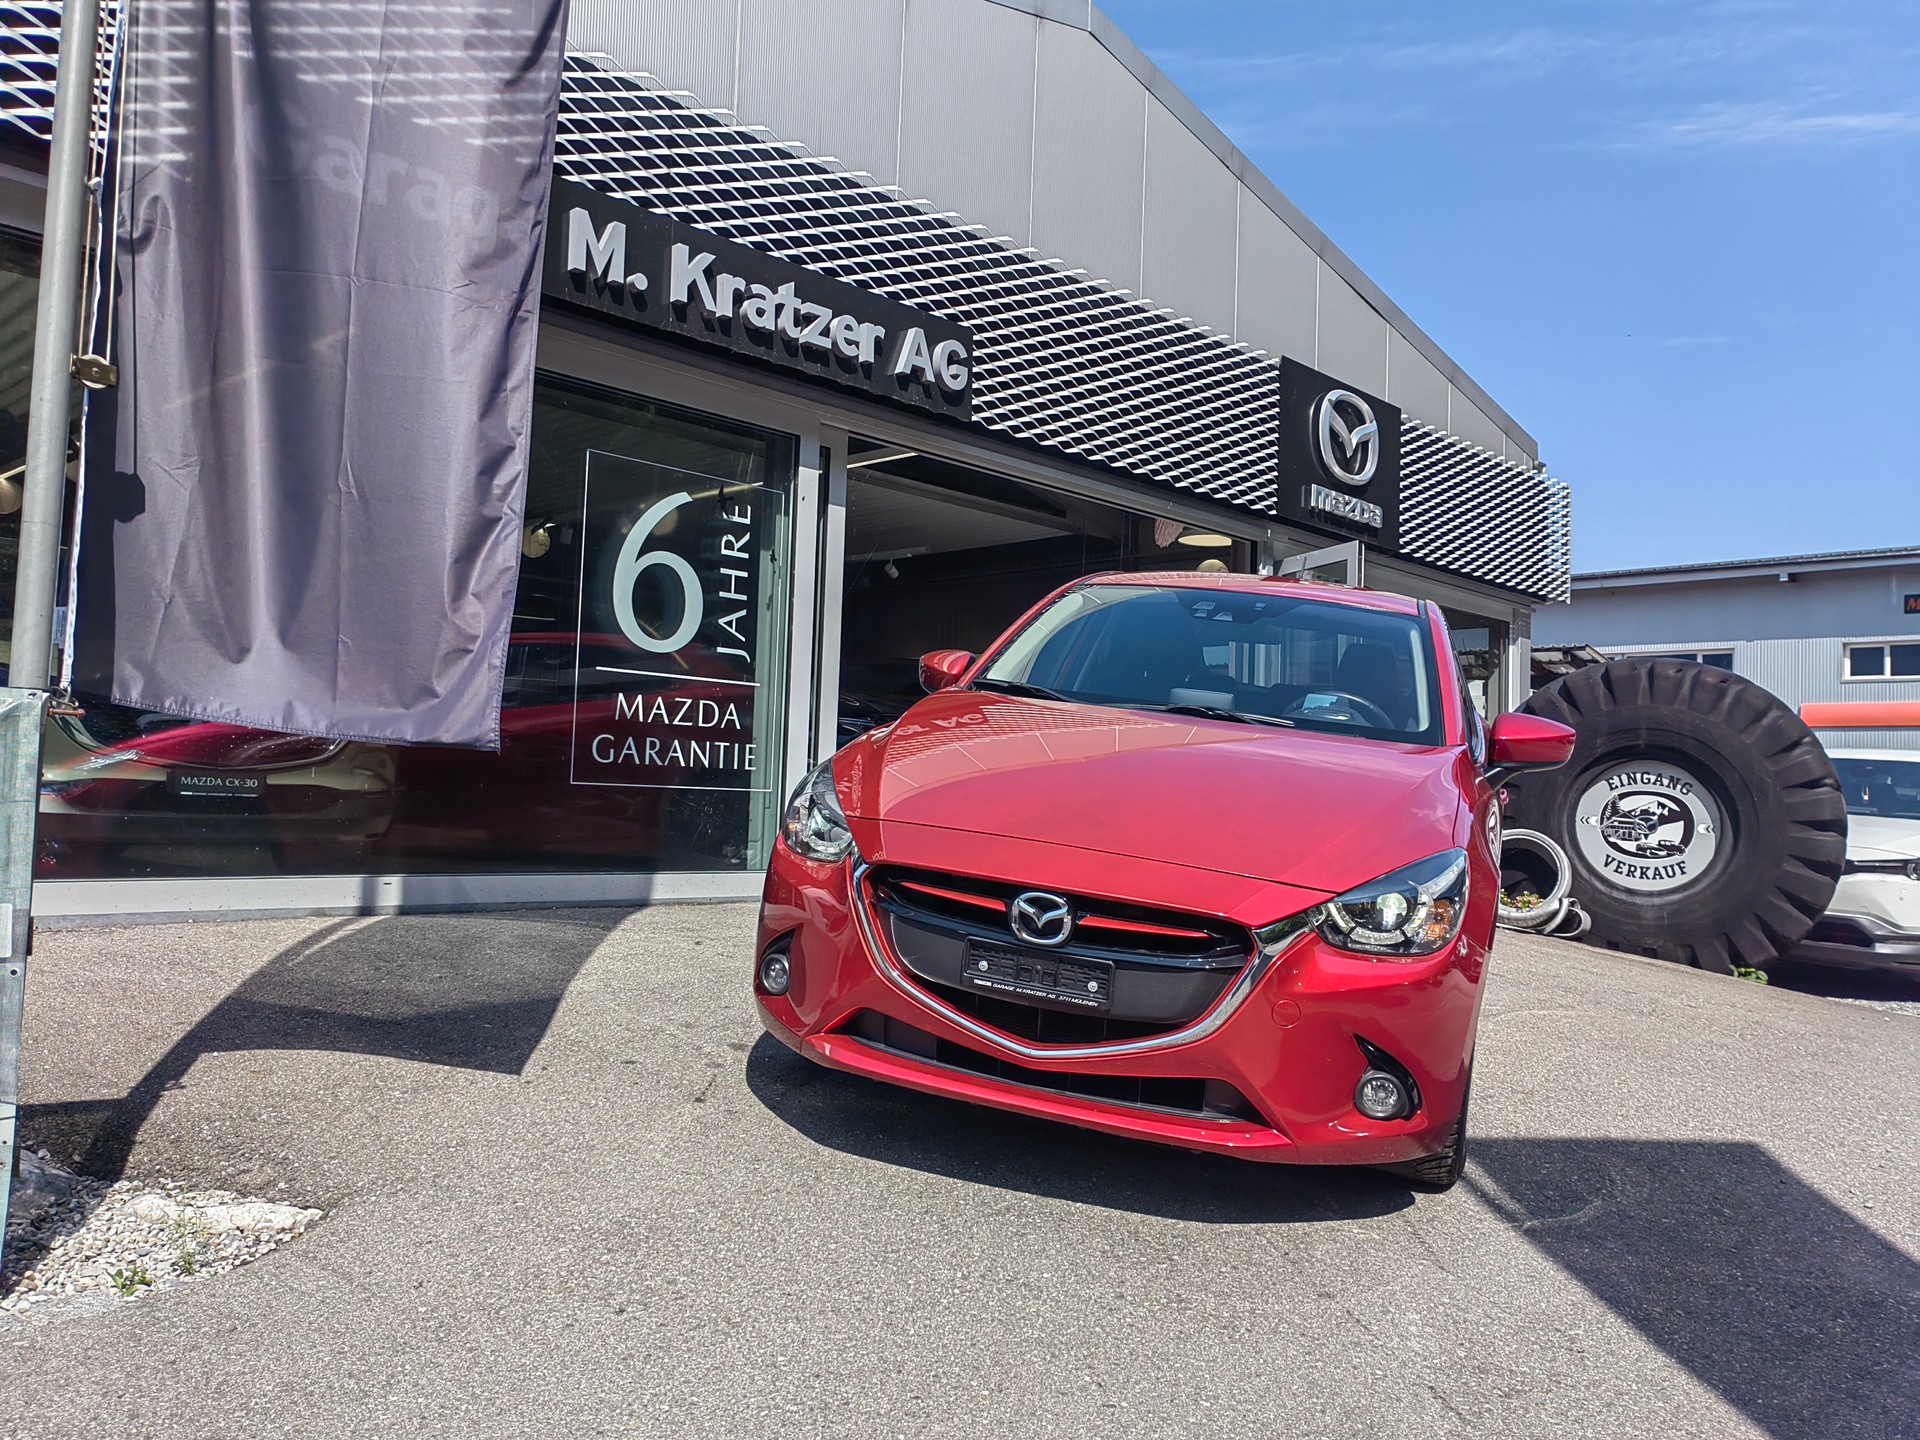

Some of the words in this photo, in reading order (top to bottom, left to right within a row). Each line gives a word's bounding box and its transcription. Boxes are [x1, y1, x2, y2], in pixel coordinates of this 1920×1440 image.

[567, 207, 648, 292] M.
[670, 243, 886, 364] Kratzer
[894, 326, 969, 391] AG
[613, 491, 704, 653] 6
[716, 503, 752, 664] JAHRE
[614, 692, 742, 730] MAZDA
[591, 734, 758, 771] GARANTIE
[180, 776, 223, 787] MAZDA
[225, 777, 259, 788] CX-30
[1605, 771, 1694, 796] EINGANG
[1603, 854, 1687, 880] VERKAUF
